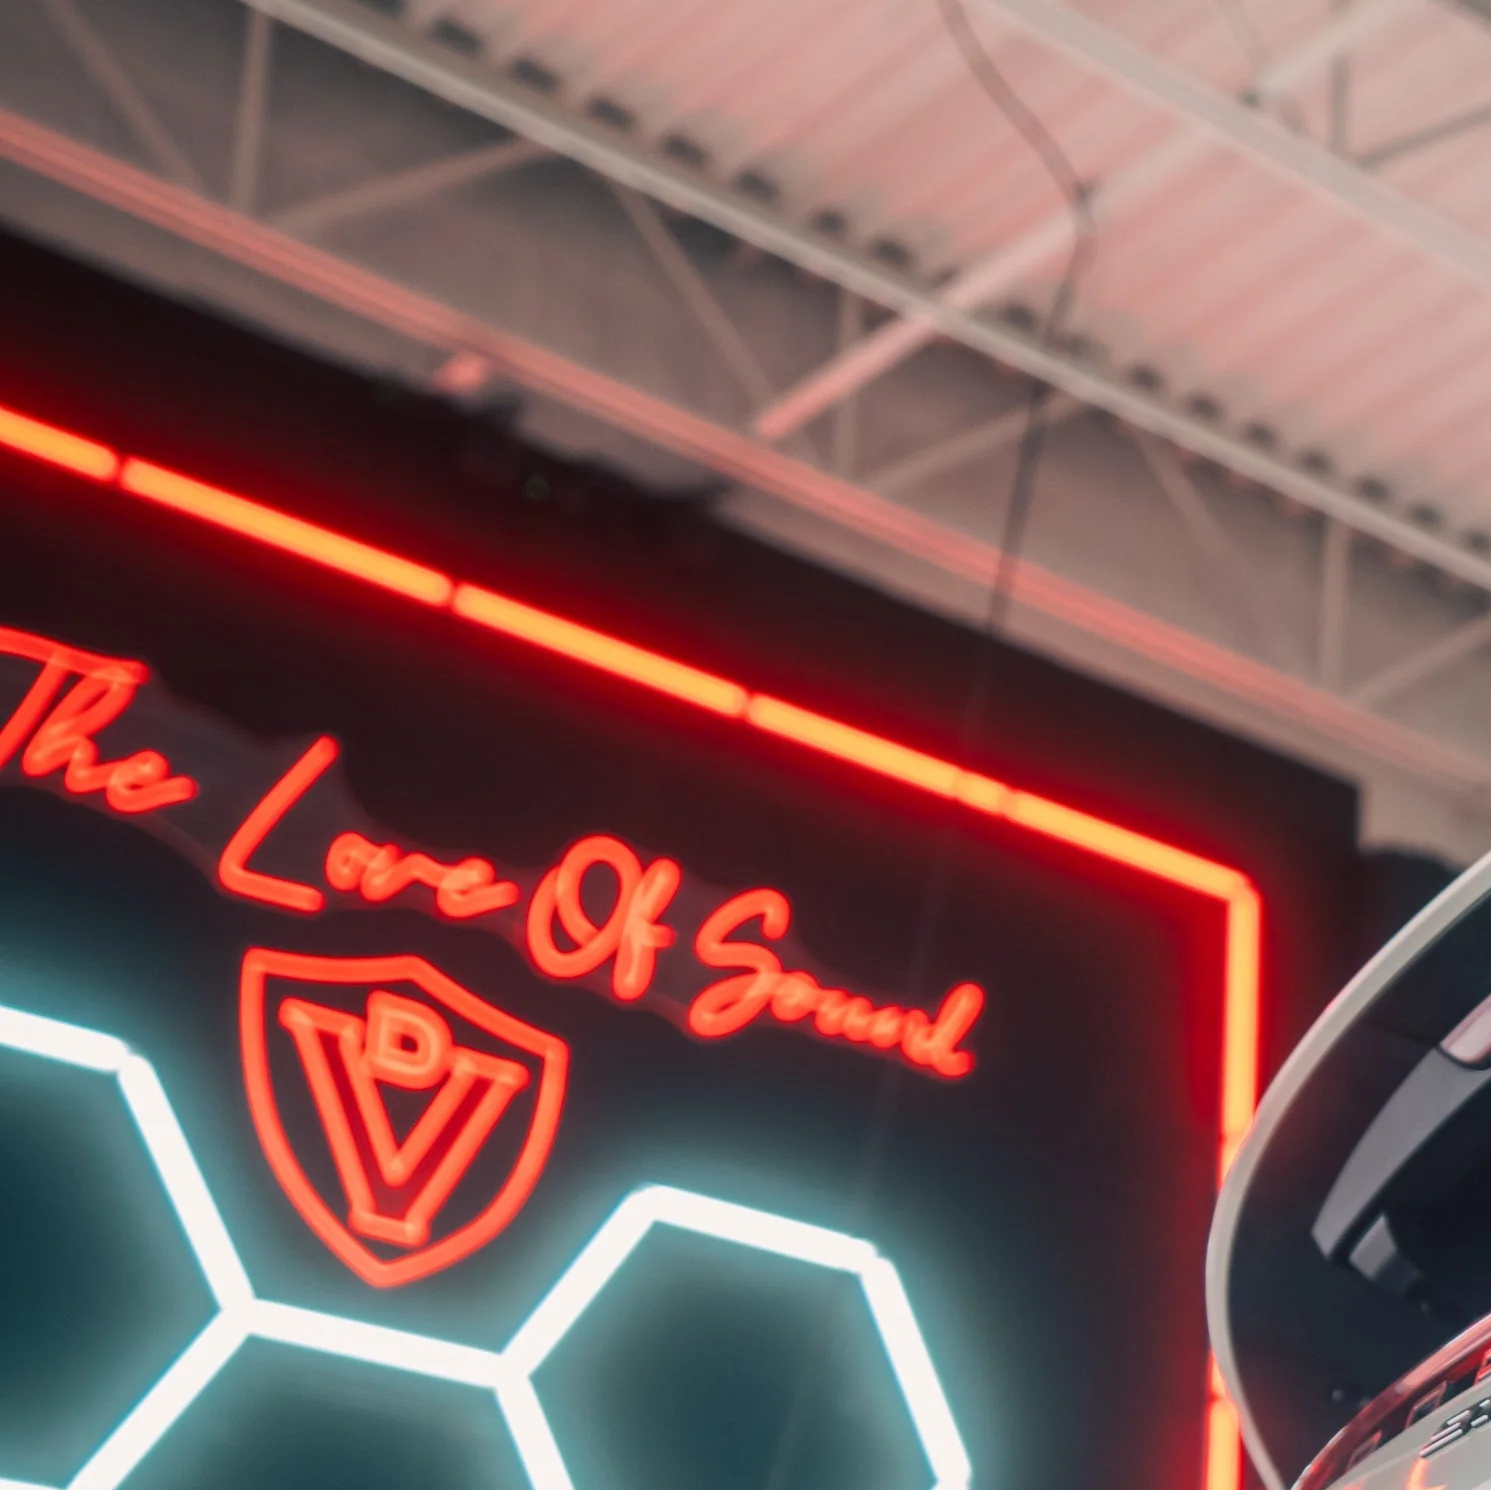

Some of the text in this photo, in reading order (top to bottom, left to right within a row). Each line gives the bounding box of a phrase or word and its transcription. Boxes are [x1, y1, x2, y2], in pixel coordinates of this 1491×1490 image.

[0, 626, 984, 1078] The Love Of Sound
